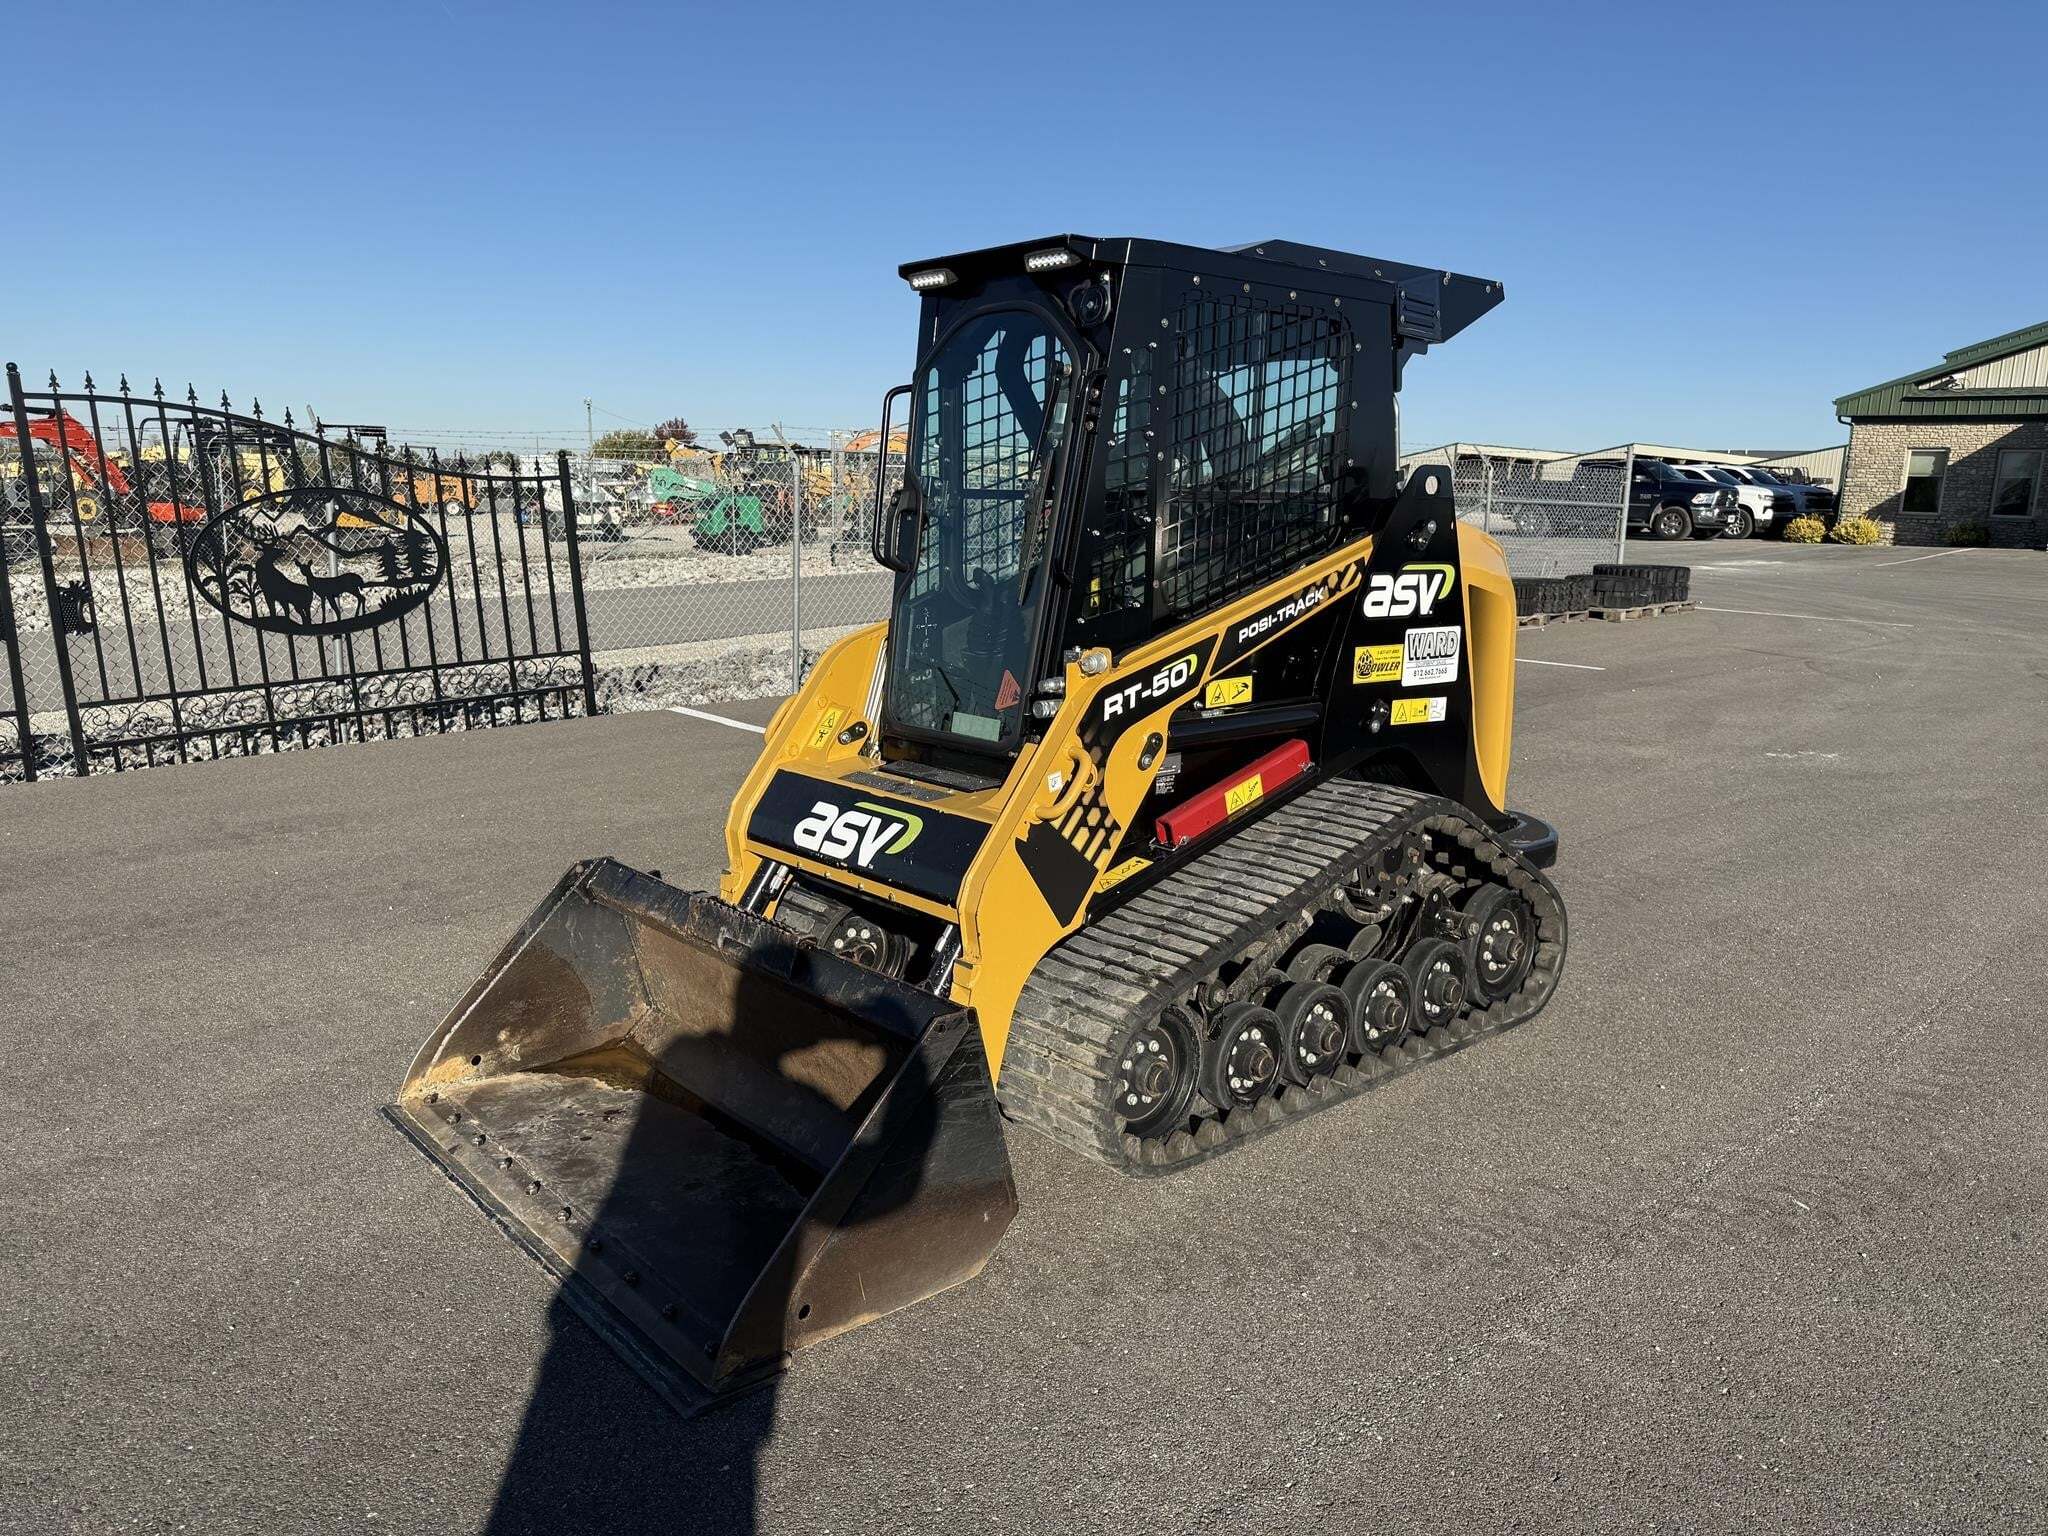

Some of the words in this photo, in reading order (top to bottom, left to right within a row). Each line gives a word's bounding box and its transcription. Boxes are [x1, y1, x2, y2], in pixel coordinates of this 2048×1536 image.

[1238, 586, 1324, 643] POSI-TRACK
[1360, 661, 1400, 673] PROWLER
[1408, 631, 1458, 661] WARD
[1103, 662, 1188, 721] RT-50
